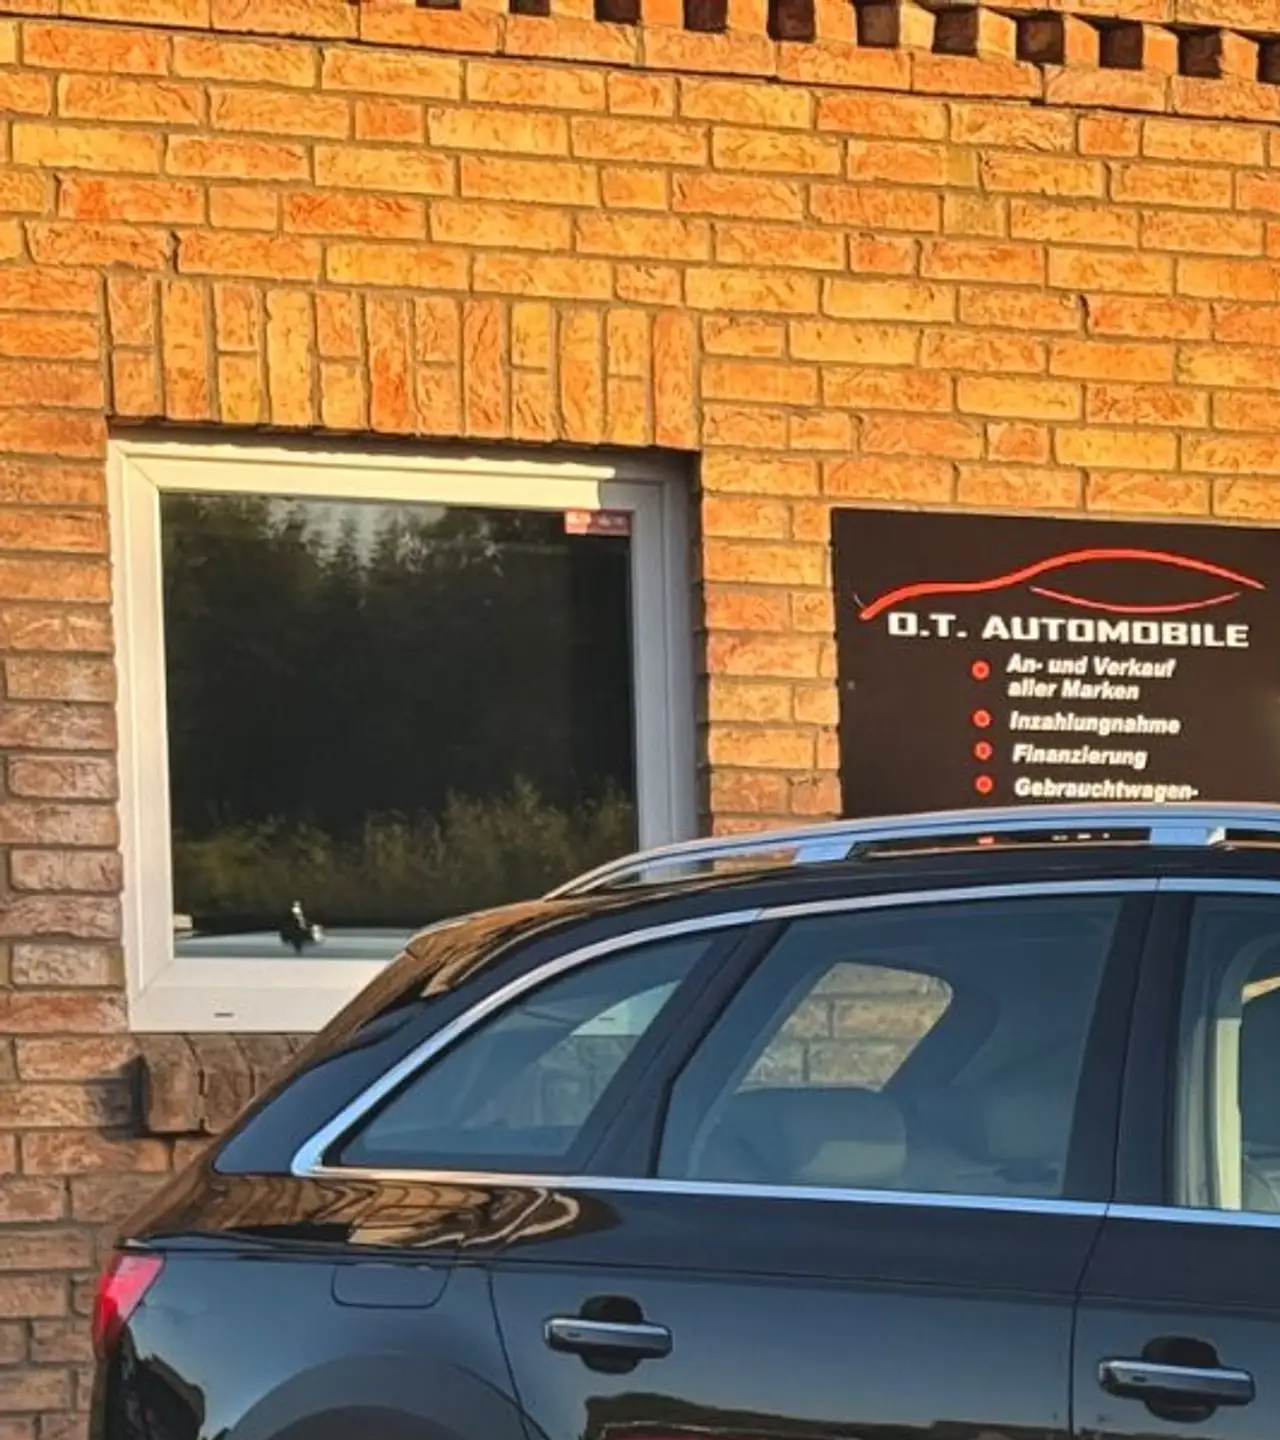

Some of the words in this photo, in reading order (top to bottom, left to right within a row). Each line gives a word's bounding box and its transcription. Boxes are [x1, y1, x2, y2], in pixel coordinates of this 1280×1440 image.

[887, 611, 968, 637] O.T.
[981, 614, 1250, 648] AUTOMOBILE
[1006, 652, 1043, 673] An-
[1048, 655, 1089, 675] und
[1093, 656, 1177, 678] Verkauf
[1007, 677, 1057, 697] aller
[1061, 679, 1140, 700] Marken
[1009, 710, 1181, 736] Inzahlungnahme
[1012, 743, 1147, 770] Finanzierung
[1014, 776, 1199, 803] Gebrauchtwagen-
